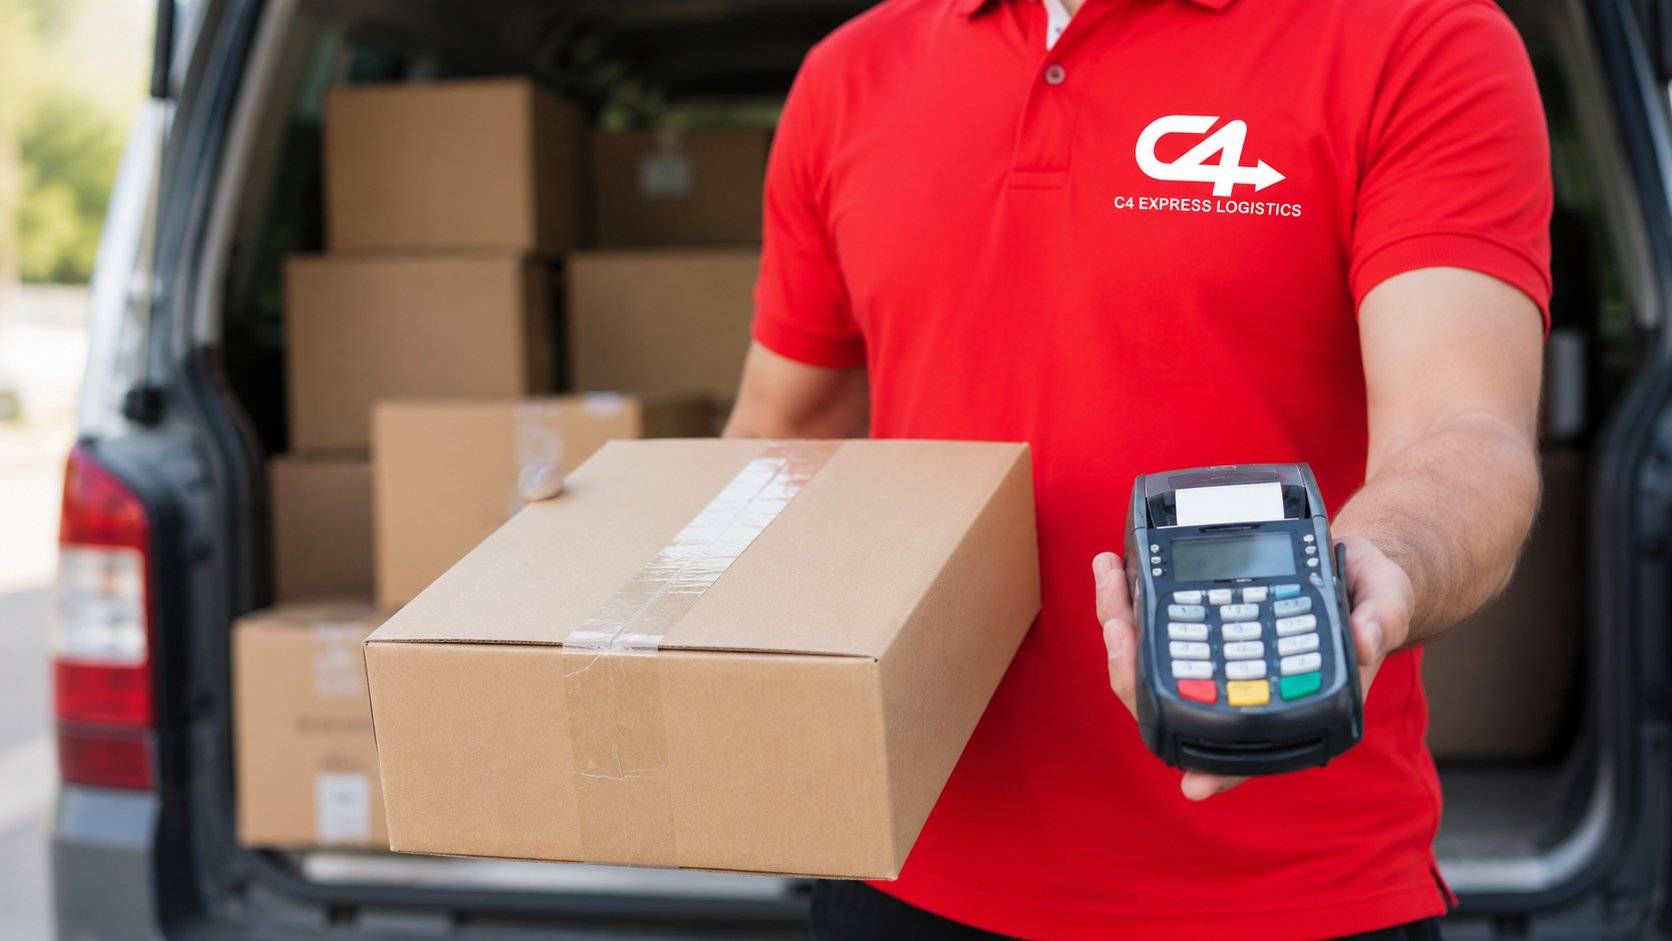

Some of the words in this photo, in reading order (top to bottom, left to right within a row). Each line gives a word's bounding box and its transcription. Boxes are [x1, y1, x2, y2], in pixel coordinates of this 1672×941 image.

[1135, 114, 1286, 197] C4
[1114, 195, 1134, 209] C4
[1139, 197, 1211, 212] EXPRESS
[1216, 200, 1302, 217] LOGISTICS
